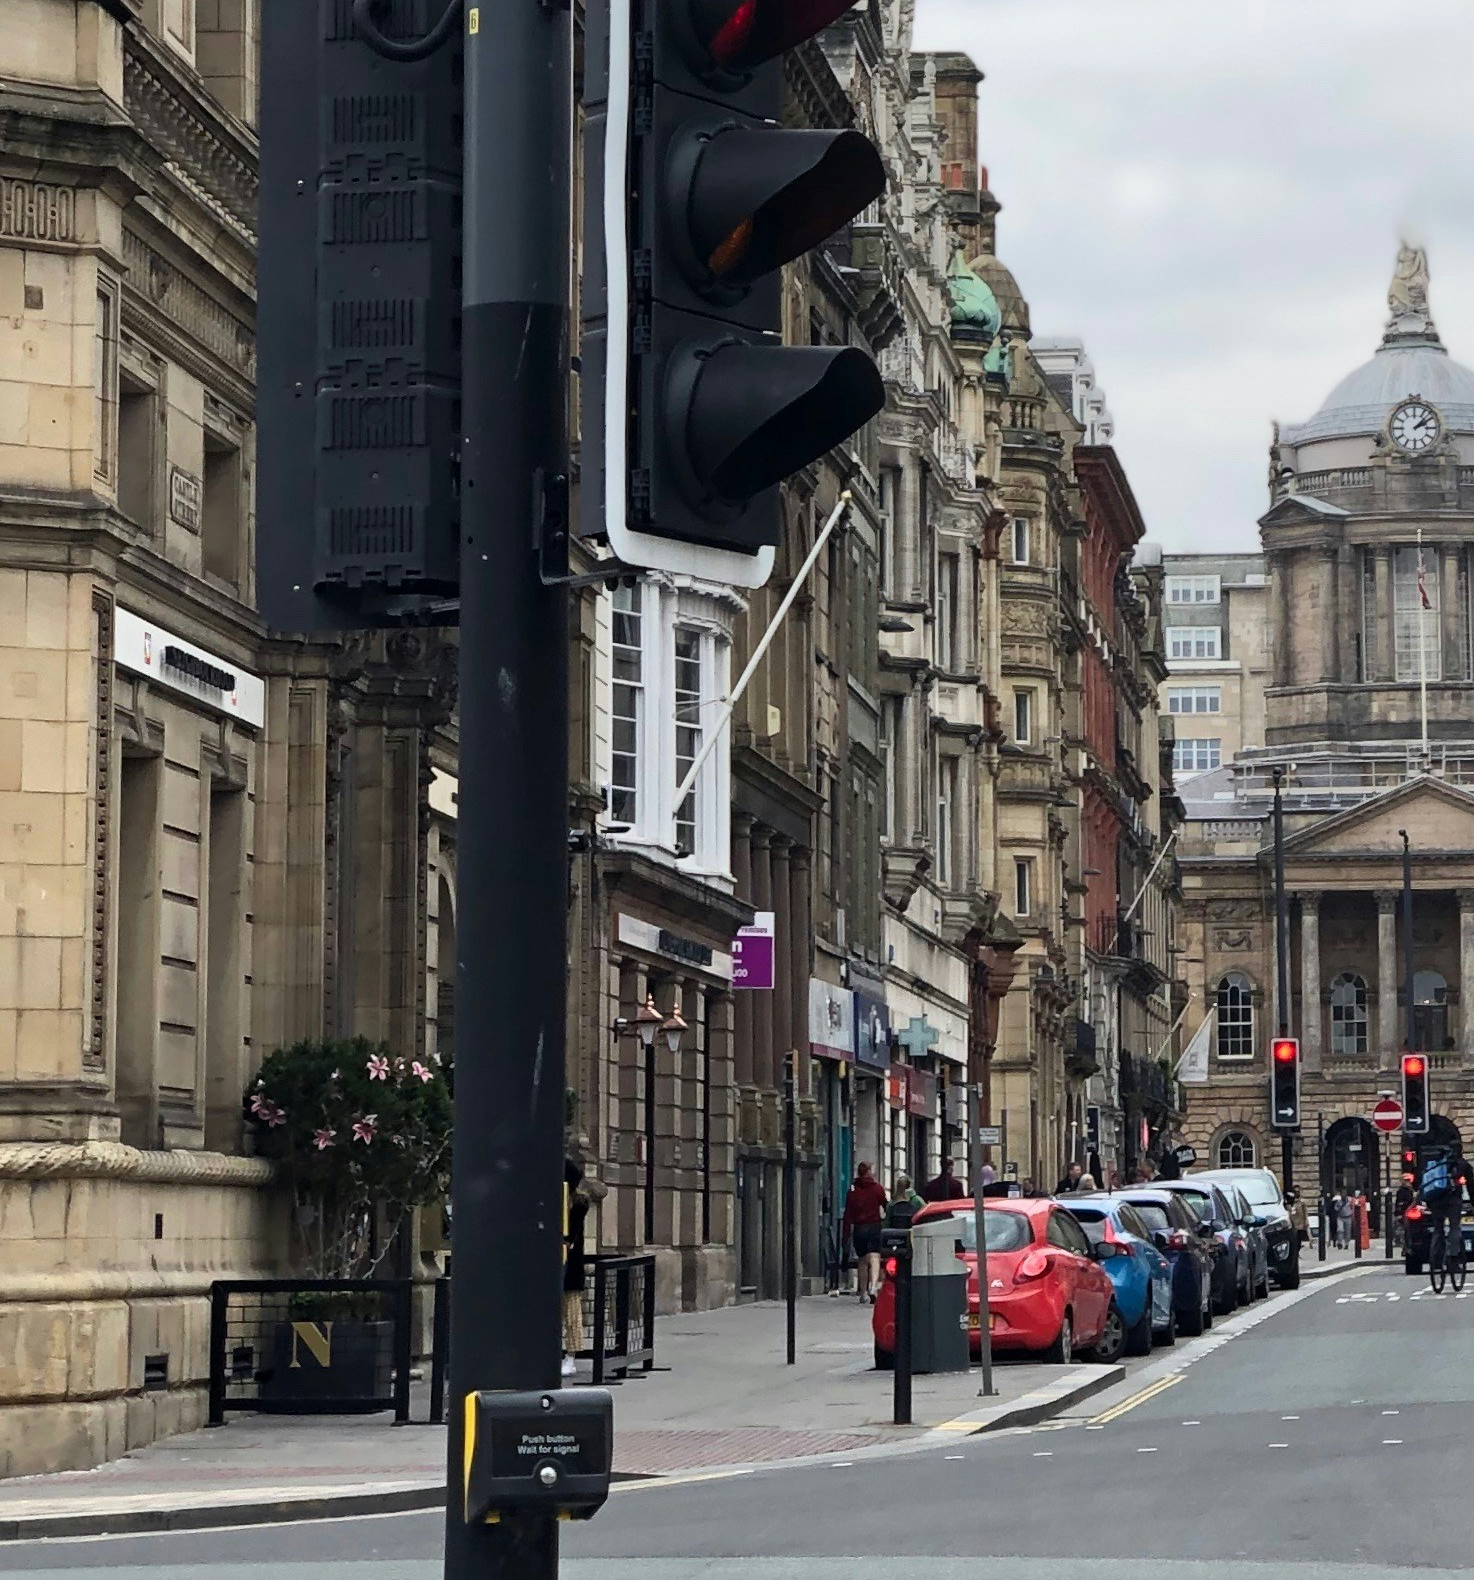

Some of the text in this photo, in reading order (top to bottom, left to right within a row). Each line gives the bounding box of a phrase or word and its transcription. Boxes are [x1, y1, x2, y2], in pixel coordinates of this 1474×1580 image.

[471, 12, 477, 29] 6
[290, 1321, 334, 1368] N
[522, 1434, 575, 1444] Push button
[517, 1444, 580, 1456] Wait for signal
